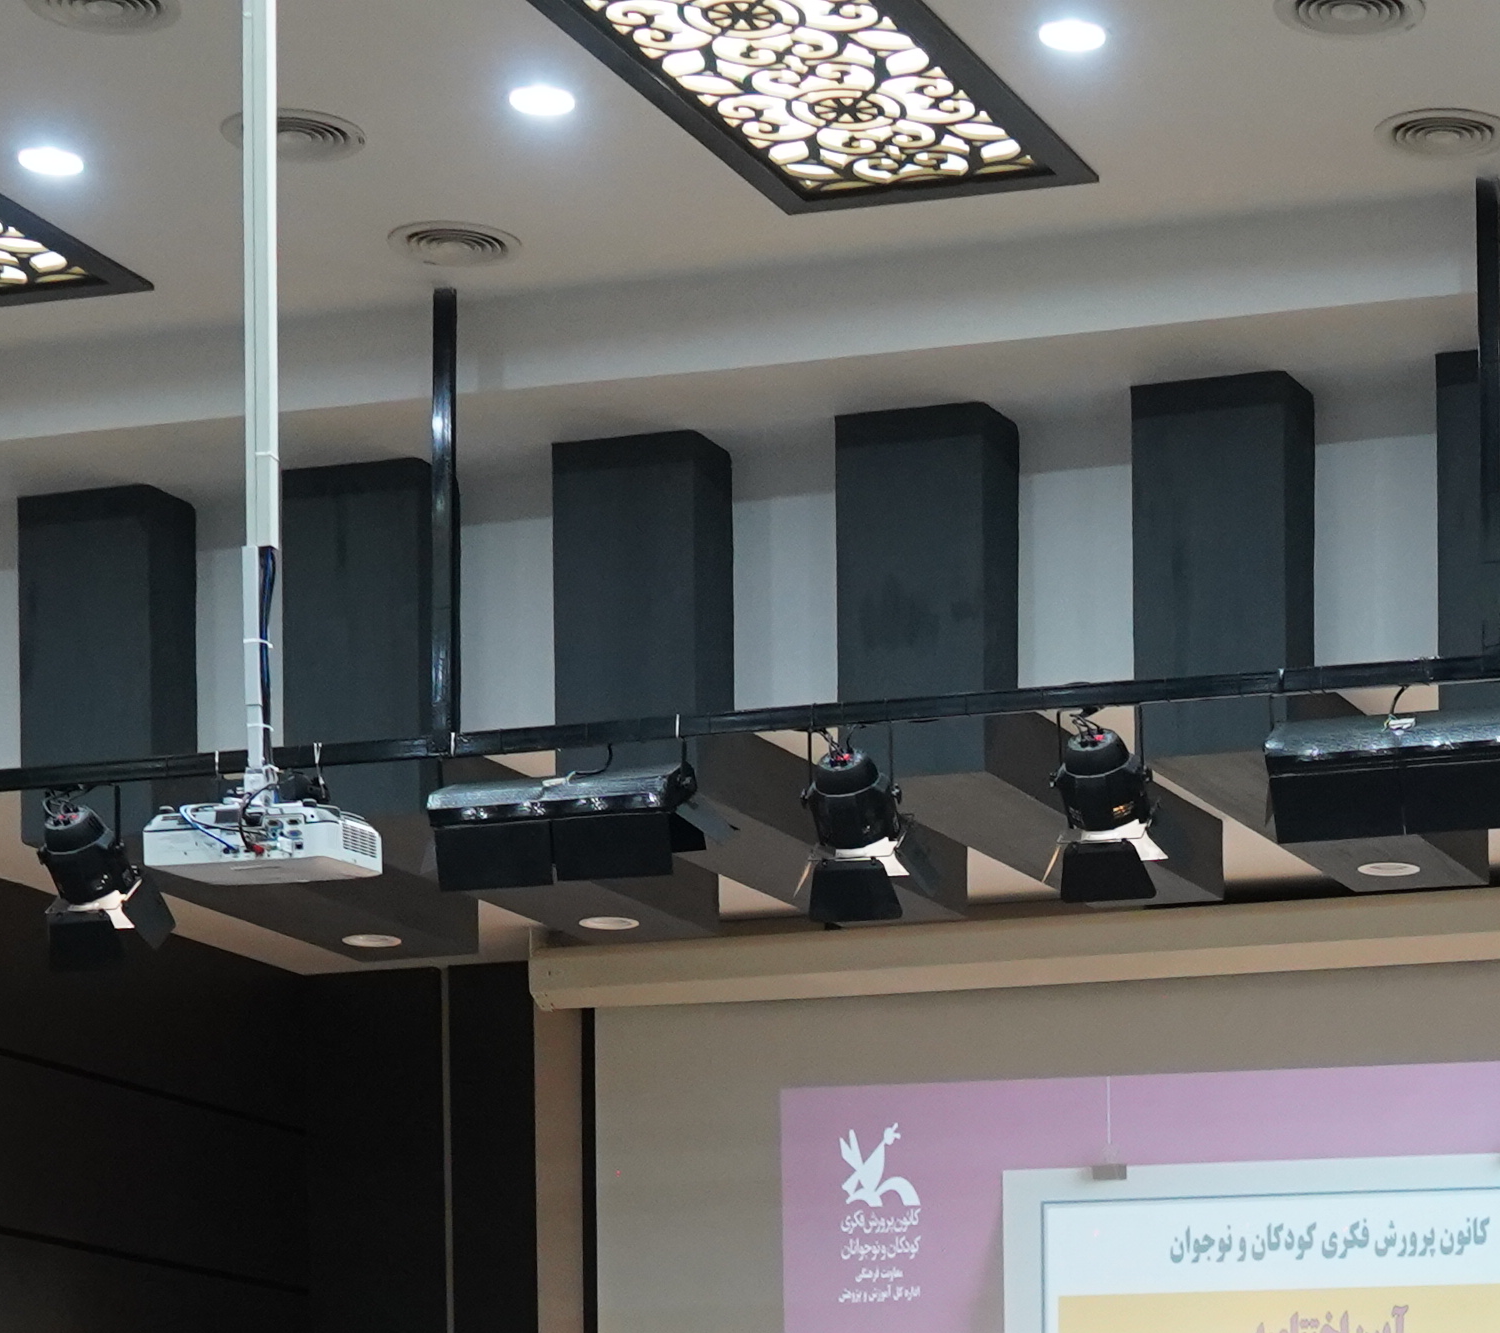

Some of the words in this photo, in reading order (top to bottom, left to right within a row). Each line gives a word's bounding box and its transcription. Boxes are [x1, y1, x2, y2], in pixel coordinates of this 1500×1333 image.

[1169, 1224, 1233, 1264] نوجوان
[1237, 1235, 1247, 1262] و
[1251, 1222, 1318, 1261] کودکان
[1321, 1218, 1371, 1259] فکری
[1374, 1220, 1436, 1258] پرورش
[1440, 1216, 1491, 1256] کانون
